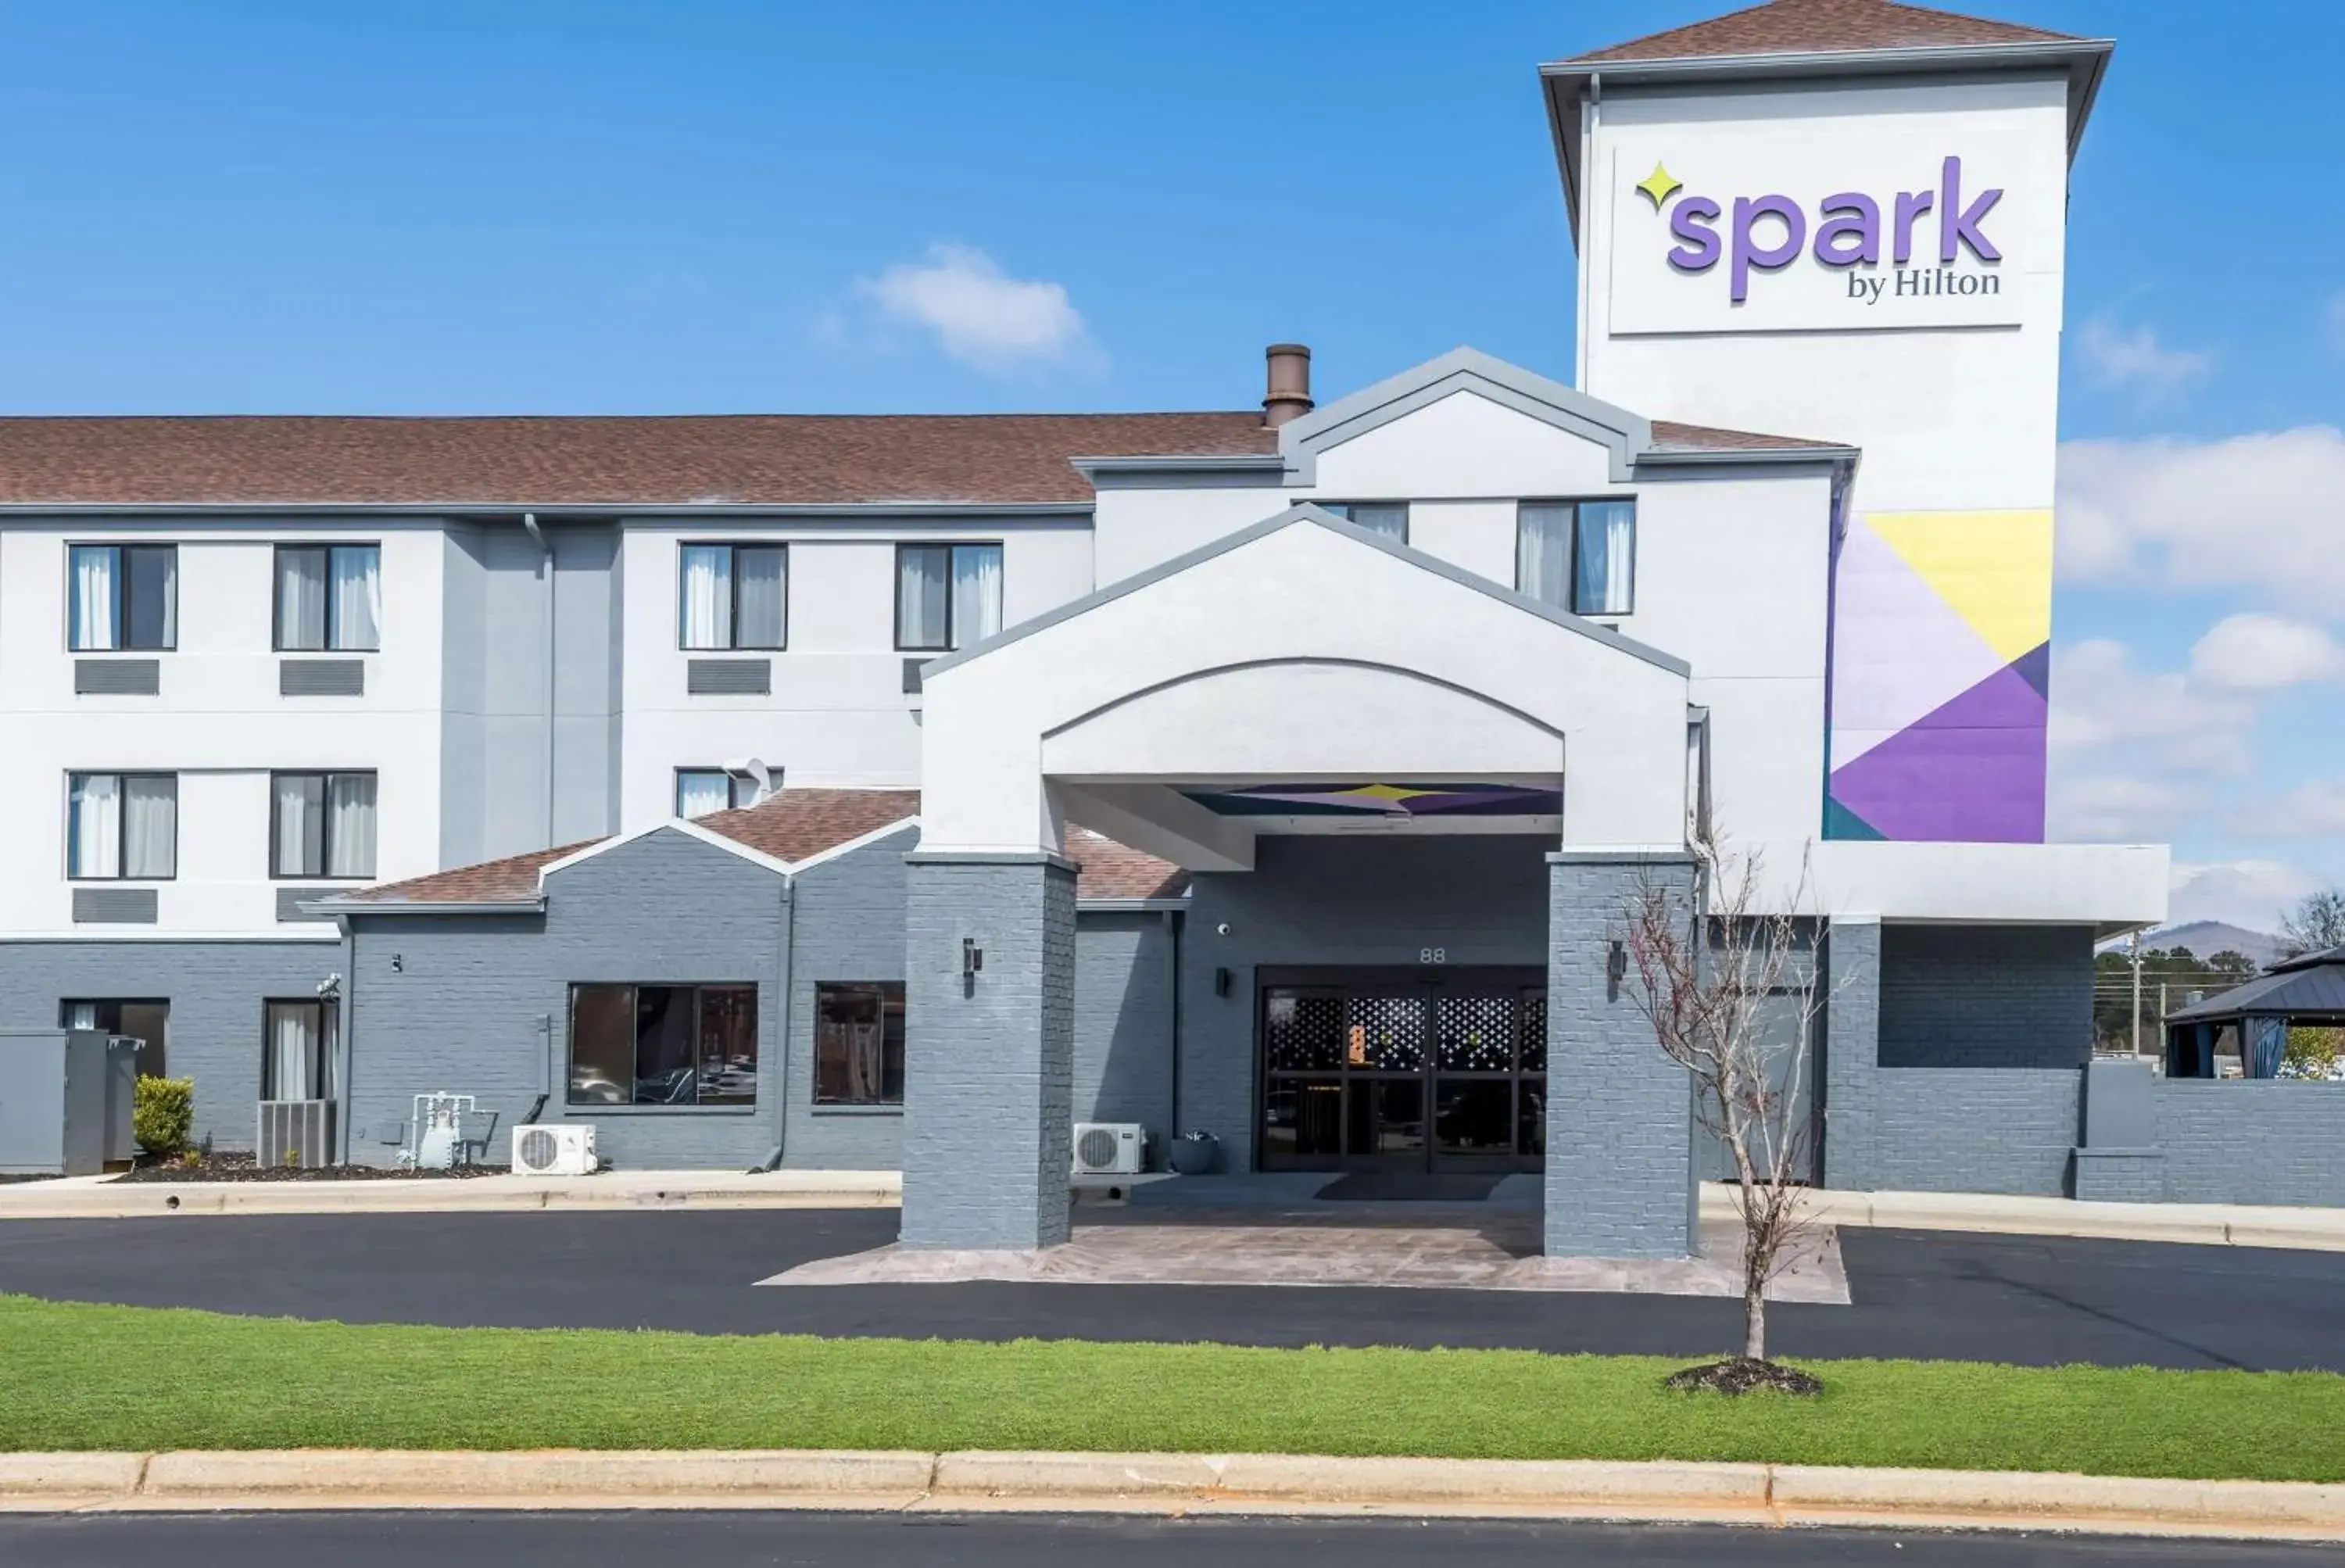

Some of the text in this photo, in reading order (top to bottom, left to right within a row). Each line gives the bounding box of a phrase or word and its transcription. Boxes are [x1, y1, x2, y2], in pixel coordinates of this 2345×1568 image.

[1667, 156, 2004, 302] spark
[1847, 268, 2001, 305] by Hilton
[1420, 947, 1445, 964] 88
